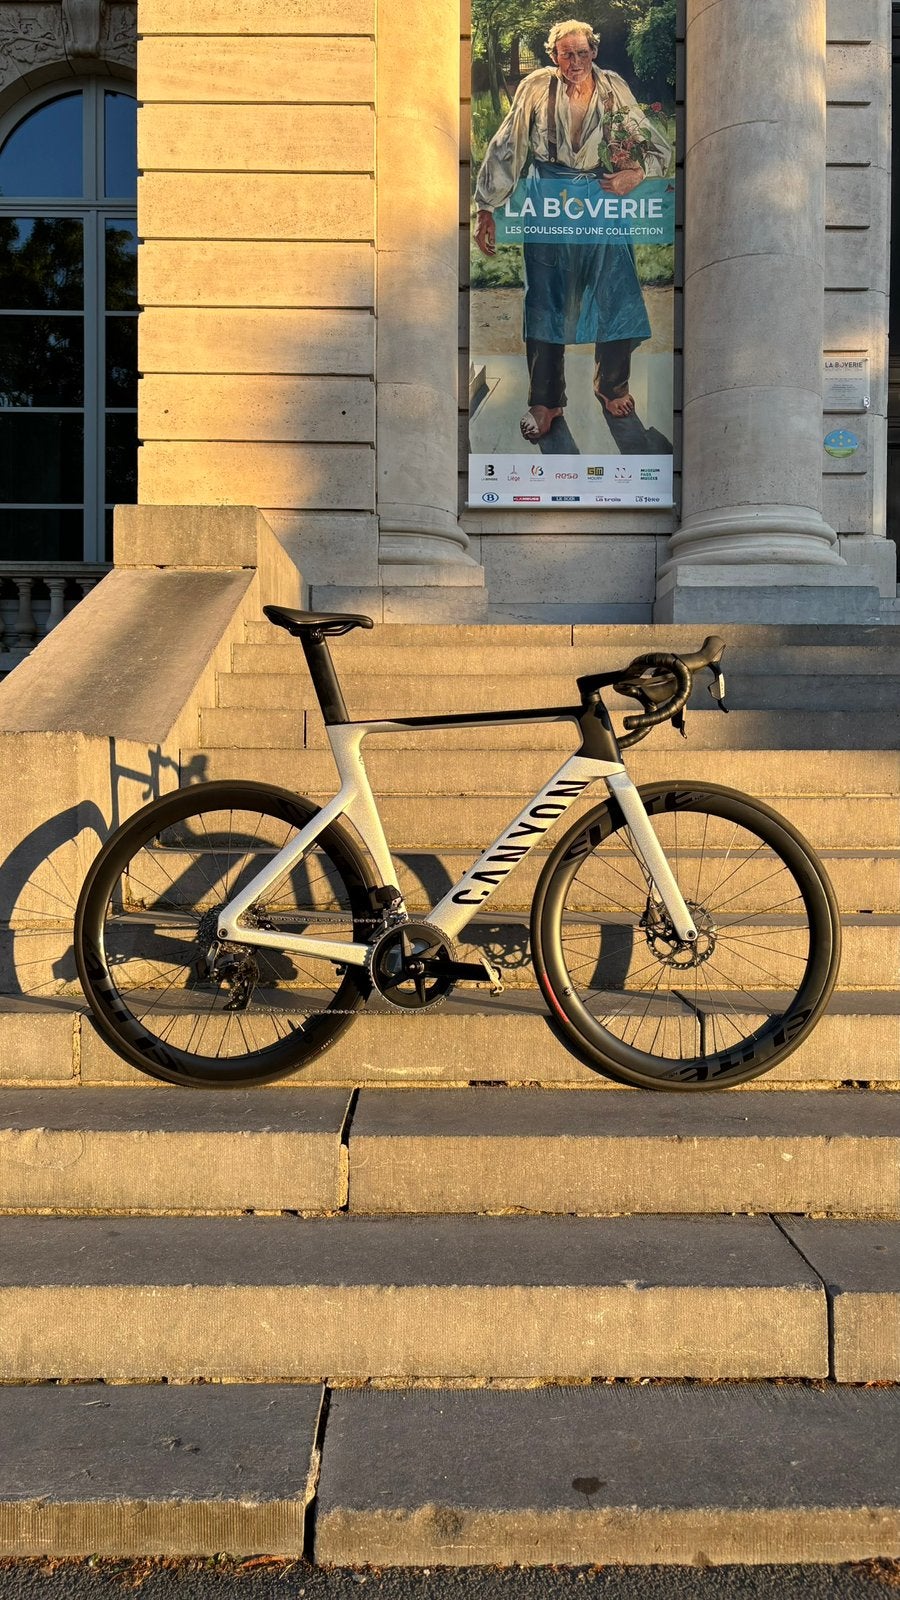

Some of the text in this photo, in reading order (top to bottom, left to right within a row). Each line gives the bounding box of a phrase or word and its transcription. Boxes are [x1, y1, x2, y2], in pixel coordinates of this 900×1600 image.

[505, 197, 663, 219] LA BOVERIE
[505, 226, 664, 235] LES COULISSES D'UNE COLLECTION
[825, 361, 863, 369] LA BOVERIE
[452, 780, 590, 905] CANYON
